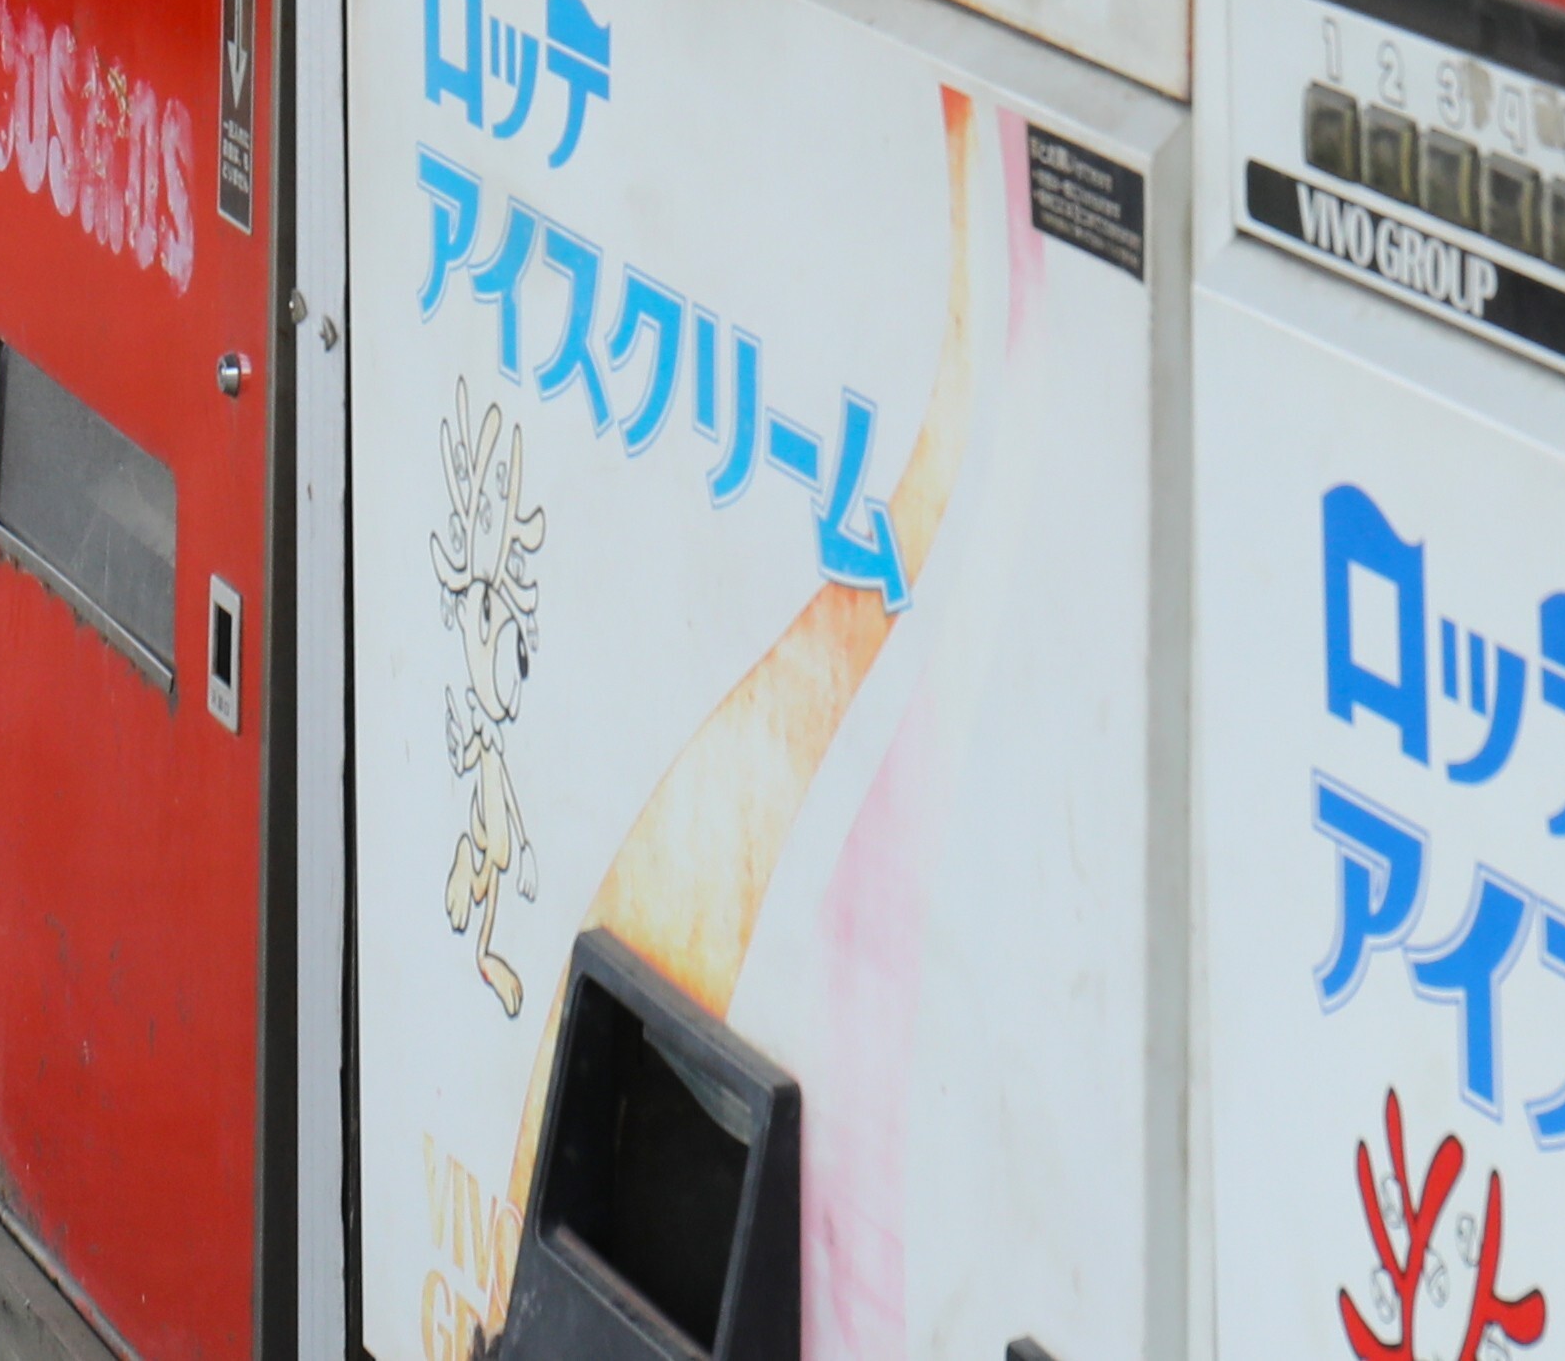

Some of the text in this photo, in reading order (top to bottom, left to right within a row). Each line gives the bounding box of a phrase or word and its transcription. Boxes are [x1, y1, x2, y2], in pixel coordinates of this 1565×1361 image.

[1322, 18, 1343, 81] 1
[1378, 42, 1406, 109] 2
[1438, 60, 1467, 130] 3
[1500, 81, 1528, 156] 4
[1296, 181, 1501, 323] VIVO GROUP
[416, 142, 913, 613] アイスクリーム
